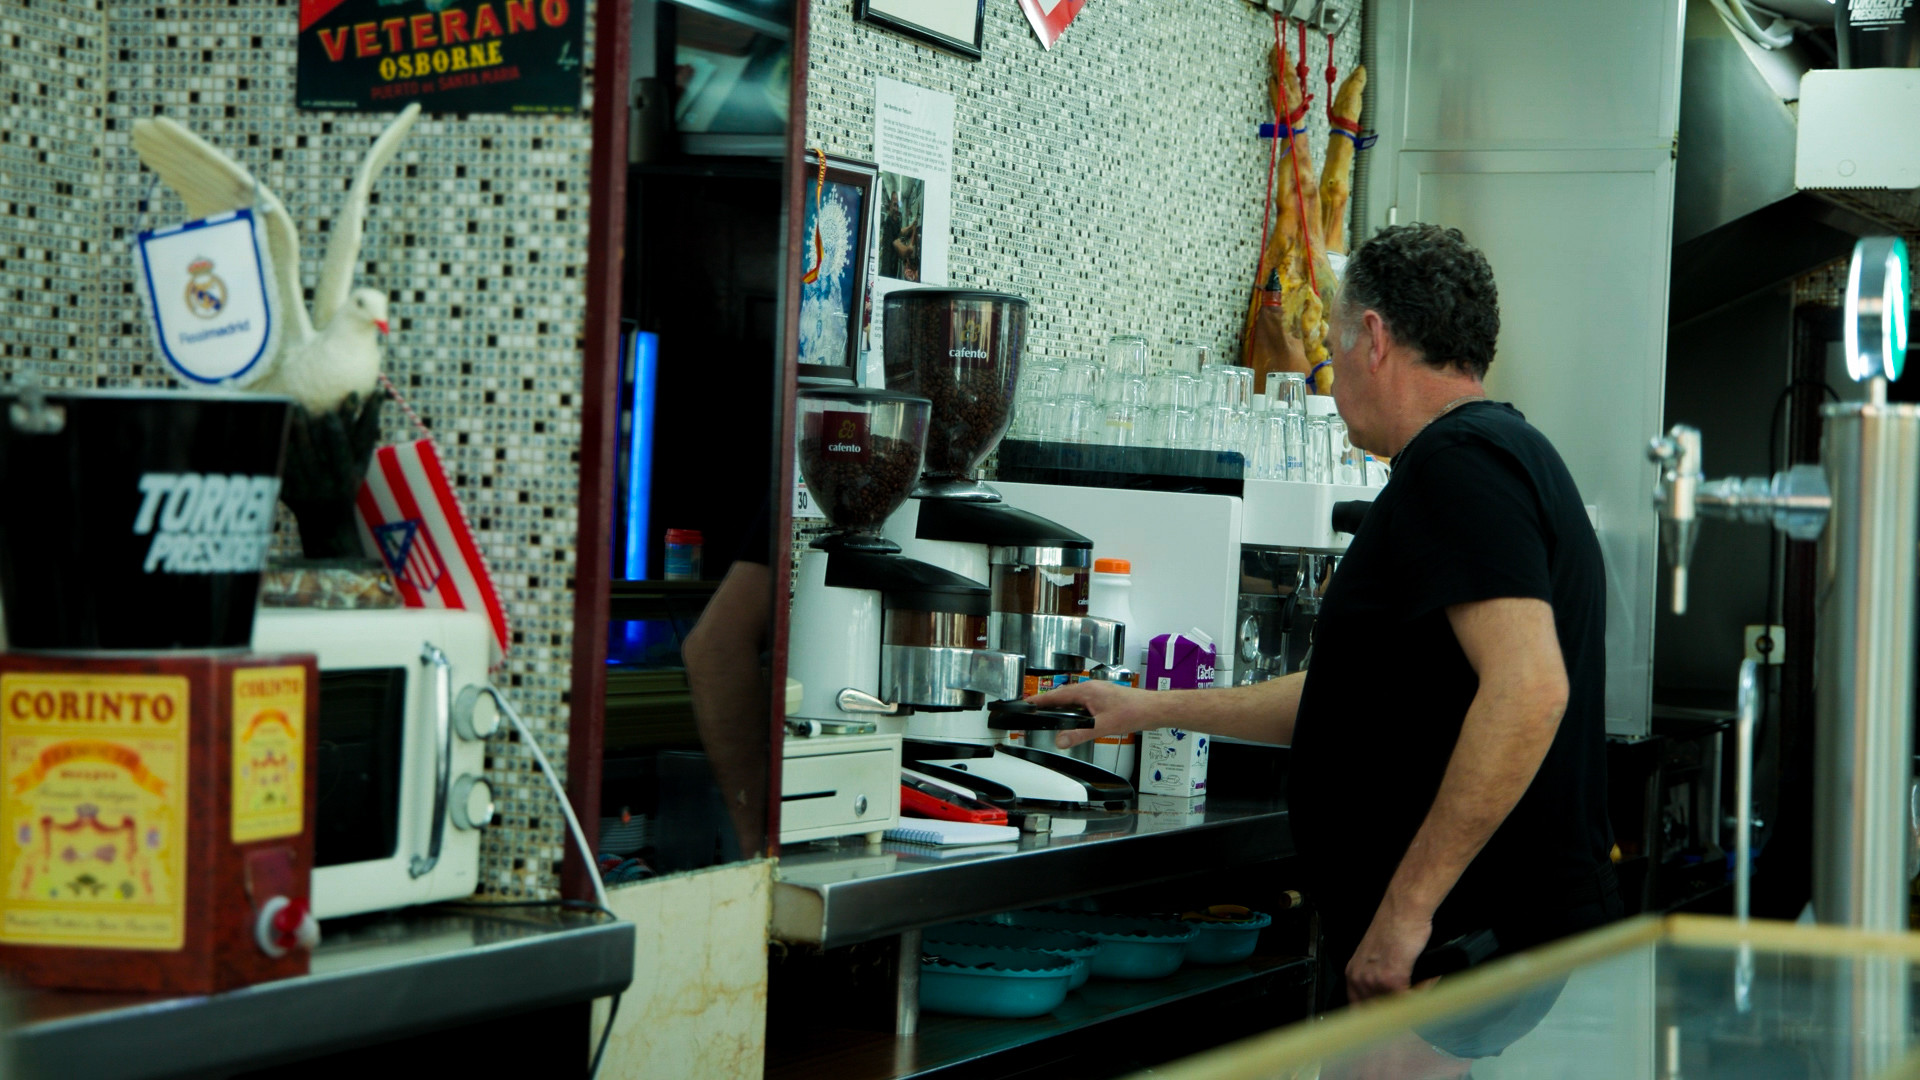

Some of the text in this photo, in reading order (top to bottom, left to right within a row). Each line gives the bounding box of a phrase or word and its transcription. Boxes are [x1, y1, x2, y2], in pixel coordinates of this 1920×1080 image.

[317, 0, 570, 62] VETERANO
[379, 41, 504, 81] OSBORNE
[370, 80, 420, 100] PUERTO
[438, 72, 480, 91] SANTA
[949, 347, 987, 359] cafento
[828, 442, 862, 453] cafento
[798, 491, 808, 510] 30
[10, 689, 175, 724] CORINTO
